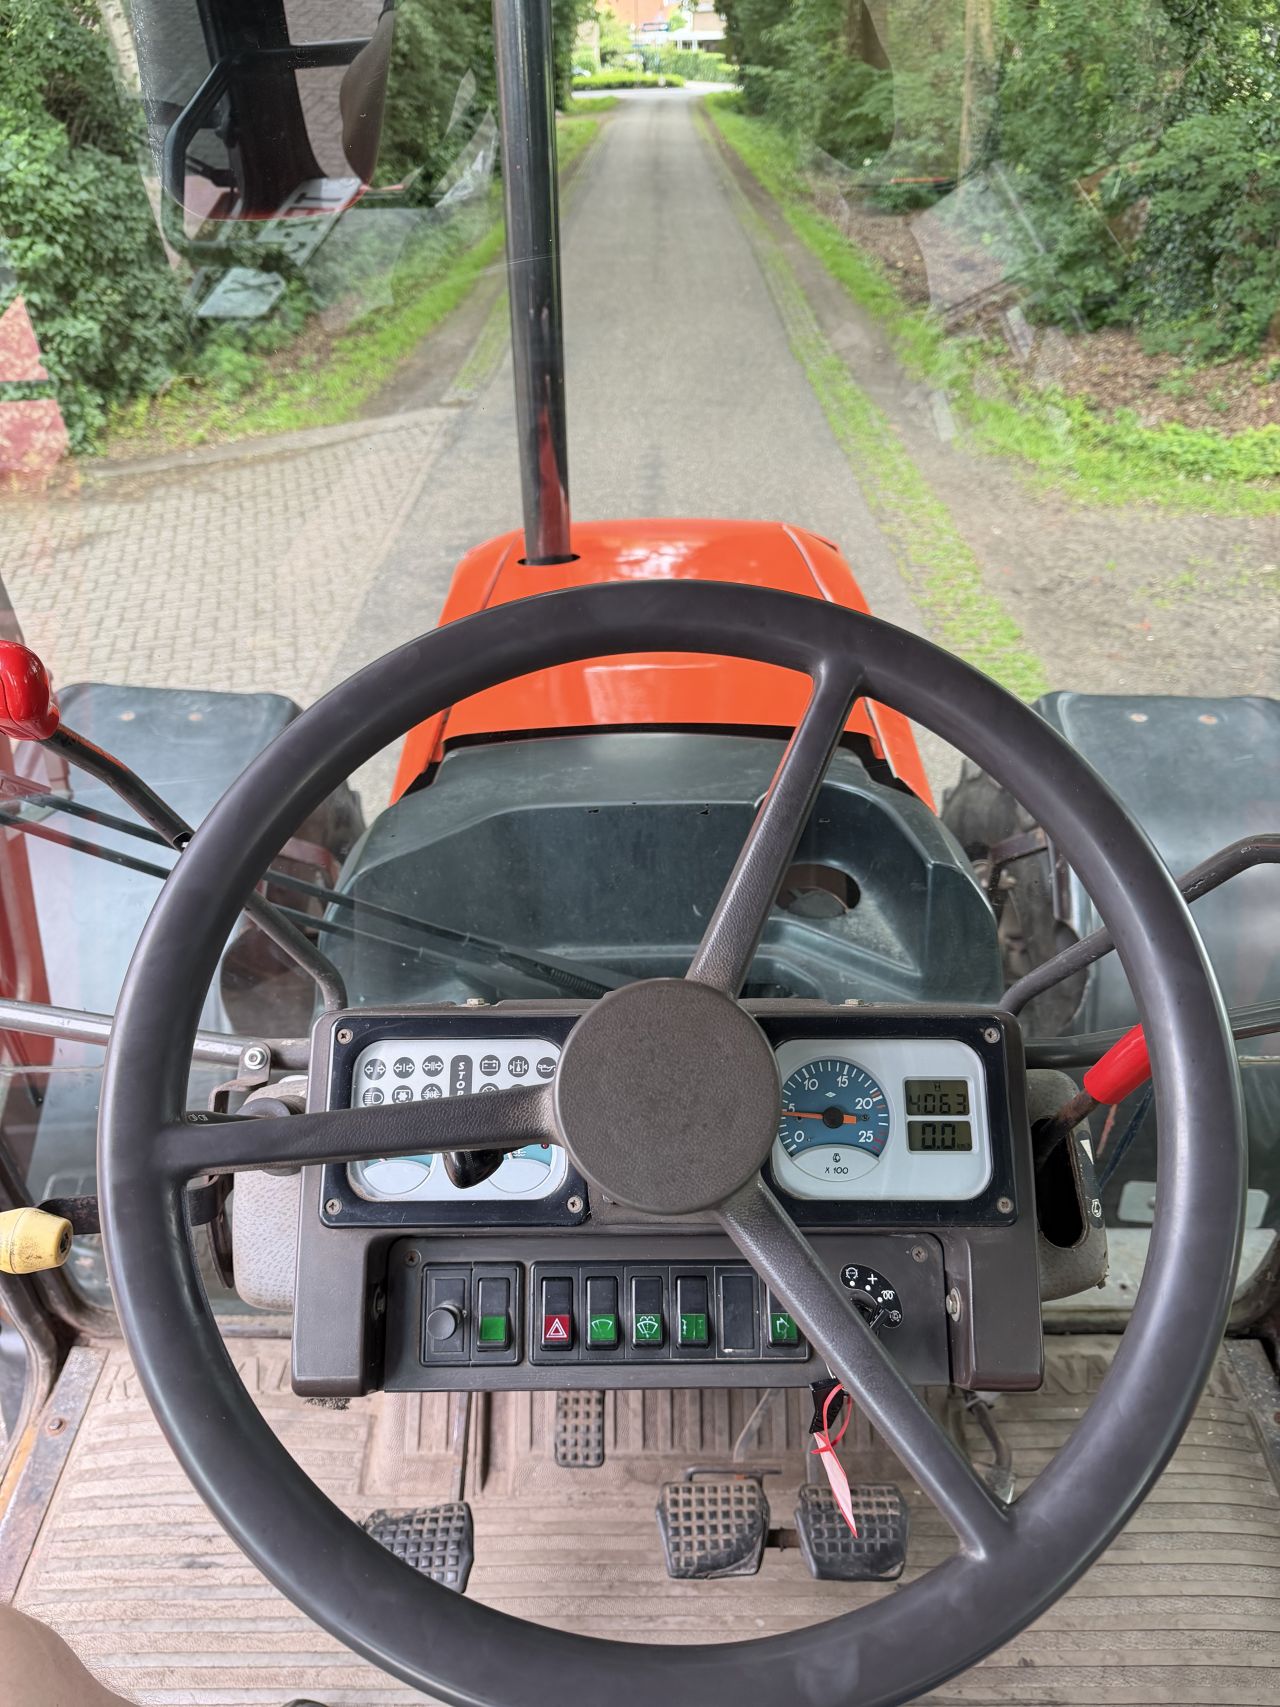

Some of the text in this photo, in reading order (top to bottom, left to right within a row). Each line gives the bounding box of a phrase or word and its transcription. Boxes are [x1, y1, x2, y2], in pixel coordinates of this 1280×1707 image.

[803, 1078, 819, 1091] 10
[836, 1075, 849, 1088] 15
[788, 1103, 796, 1113] 5
[855, 1097, 873, 1110] 20
[909, 1093, 967, 1114] 4063
[794, 1130, 805, 1143] 0
[858, 1130, 874, 1143] 25
[921, 1123, 956, 1150] 0.0
[833, 1166, 849, 1175] 100
